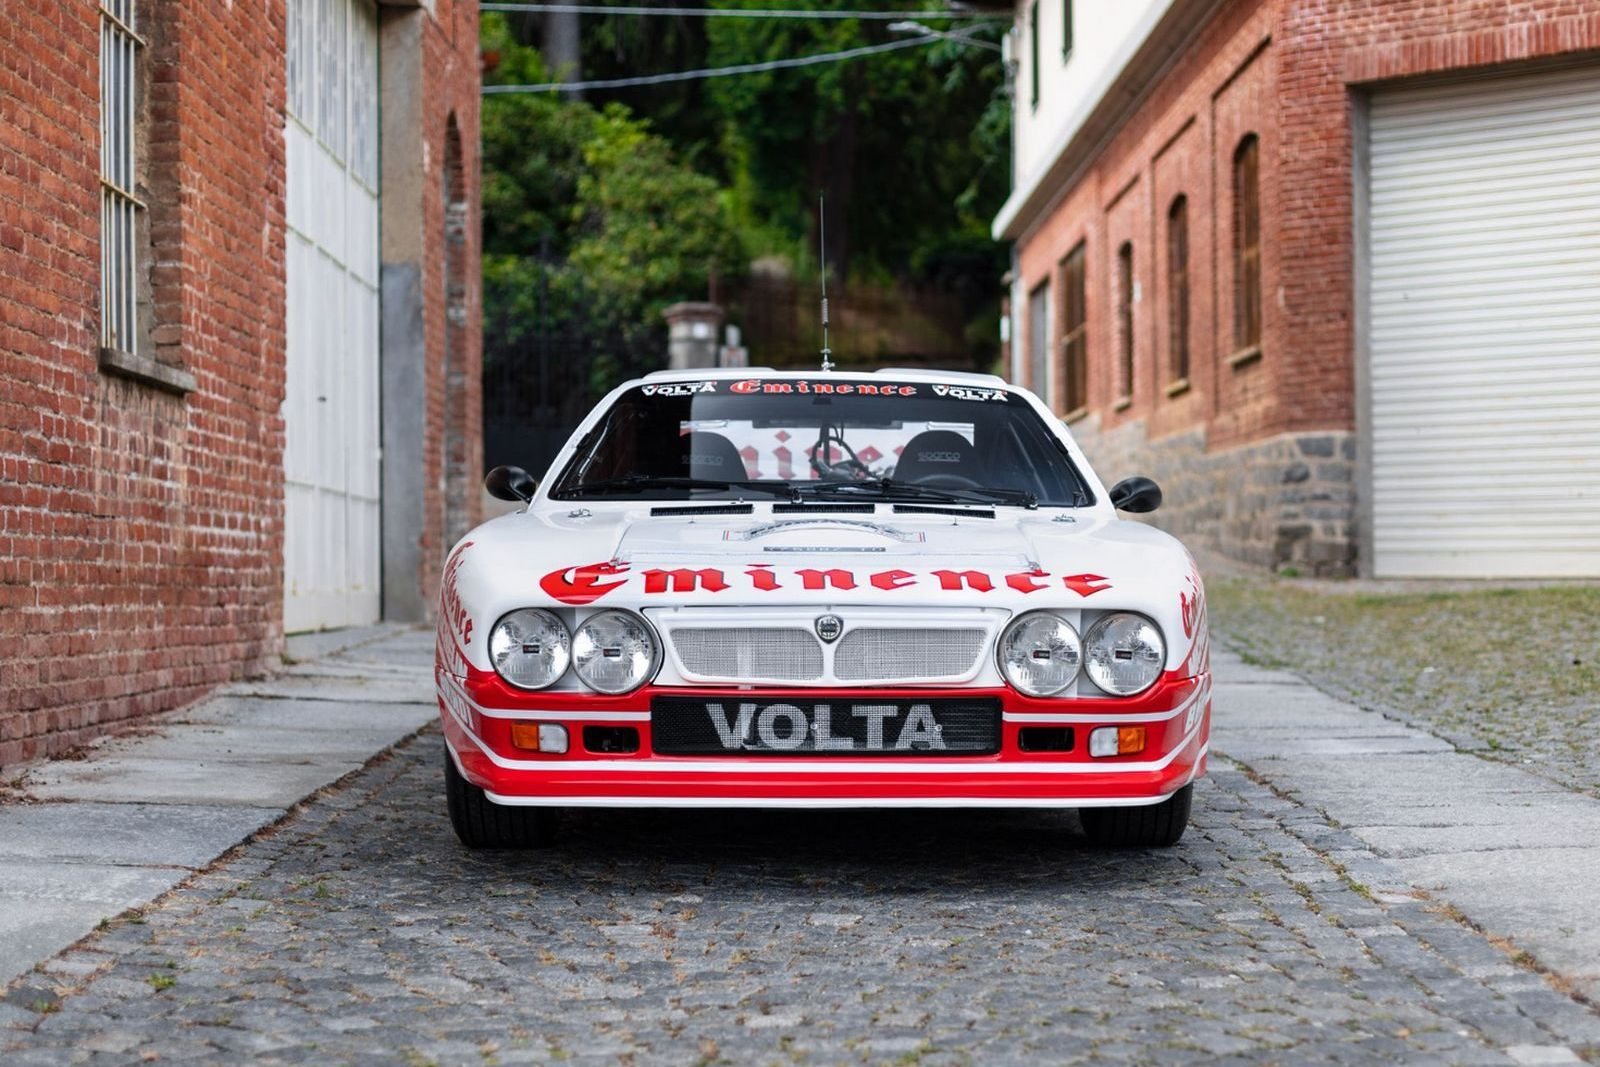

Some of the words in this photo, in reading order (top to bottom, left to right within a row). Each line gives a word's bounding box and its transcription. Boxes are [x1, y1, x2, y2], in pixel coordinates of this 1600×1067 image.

[641, 381, 717, 397] VOLTA
[730, 379, 917, 396] Eminence
[932, 384, 1008, 402] VOLTA
[539, 558, 1113, 606] Eminence
[705, 703, 947, 751] VOLTA
